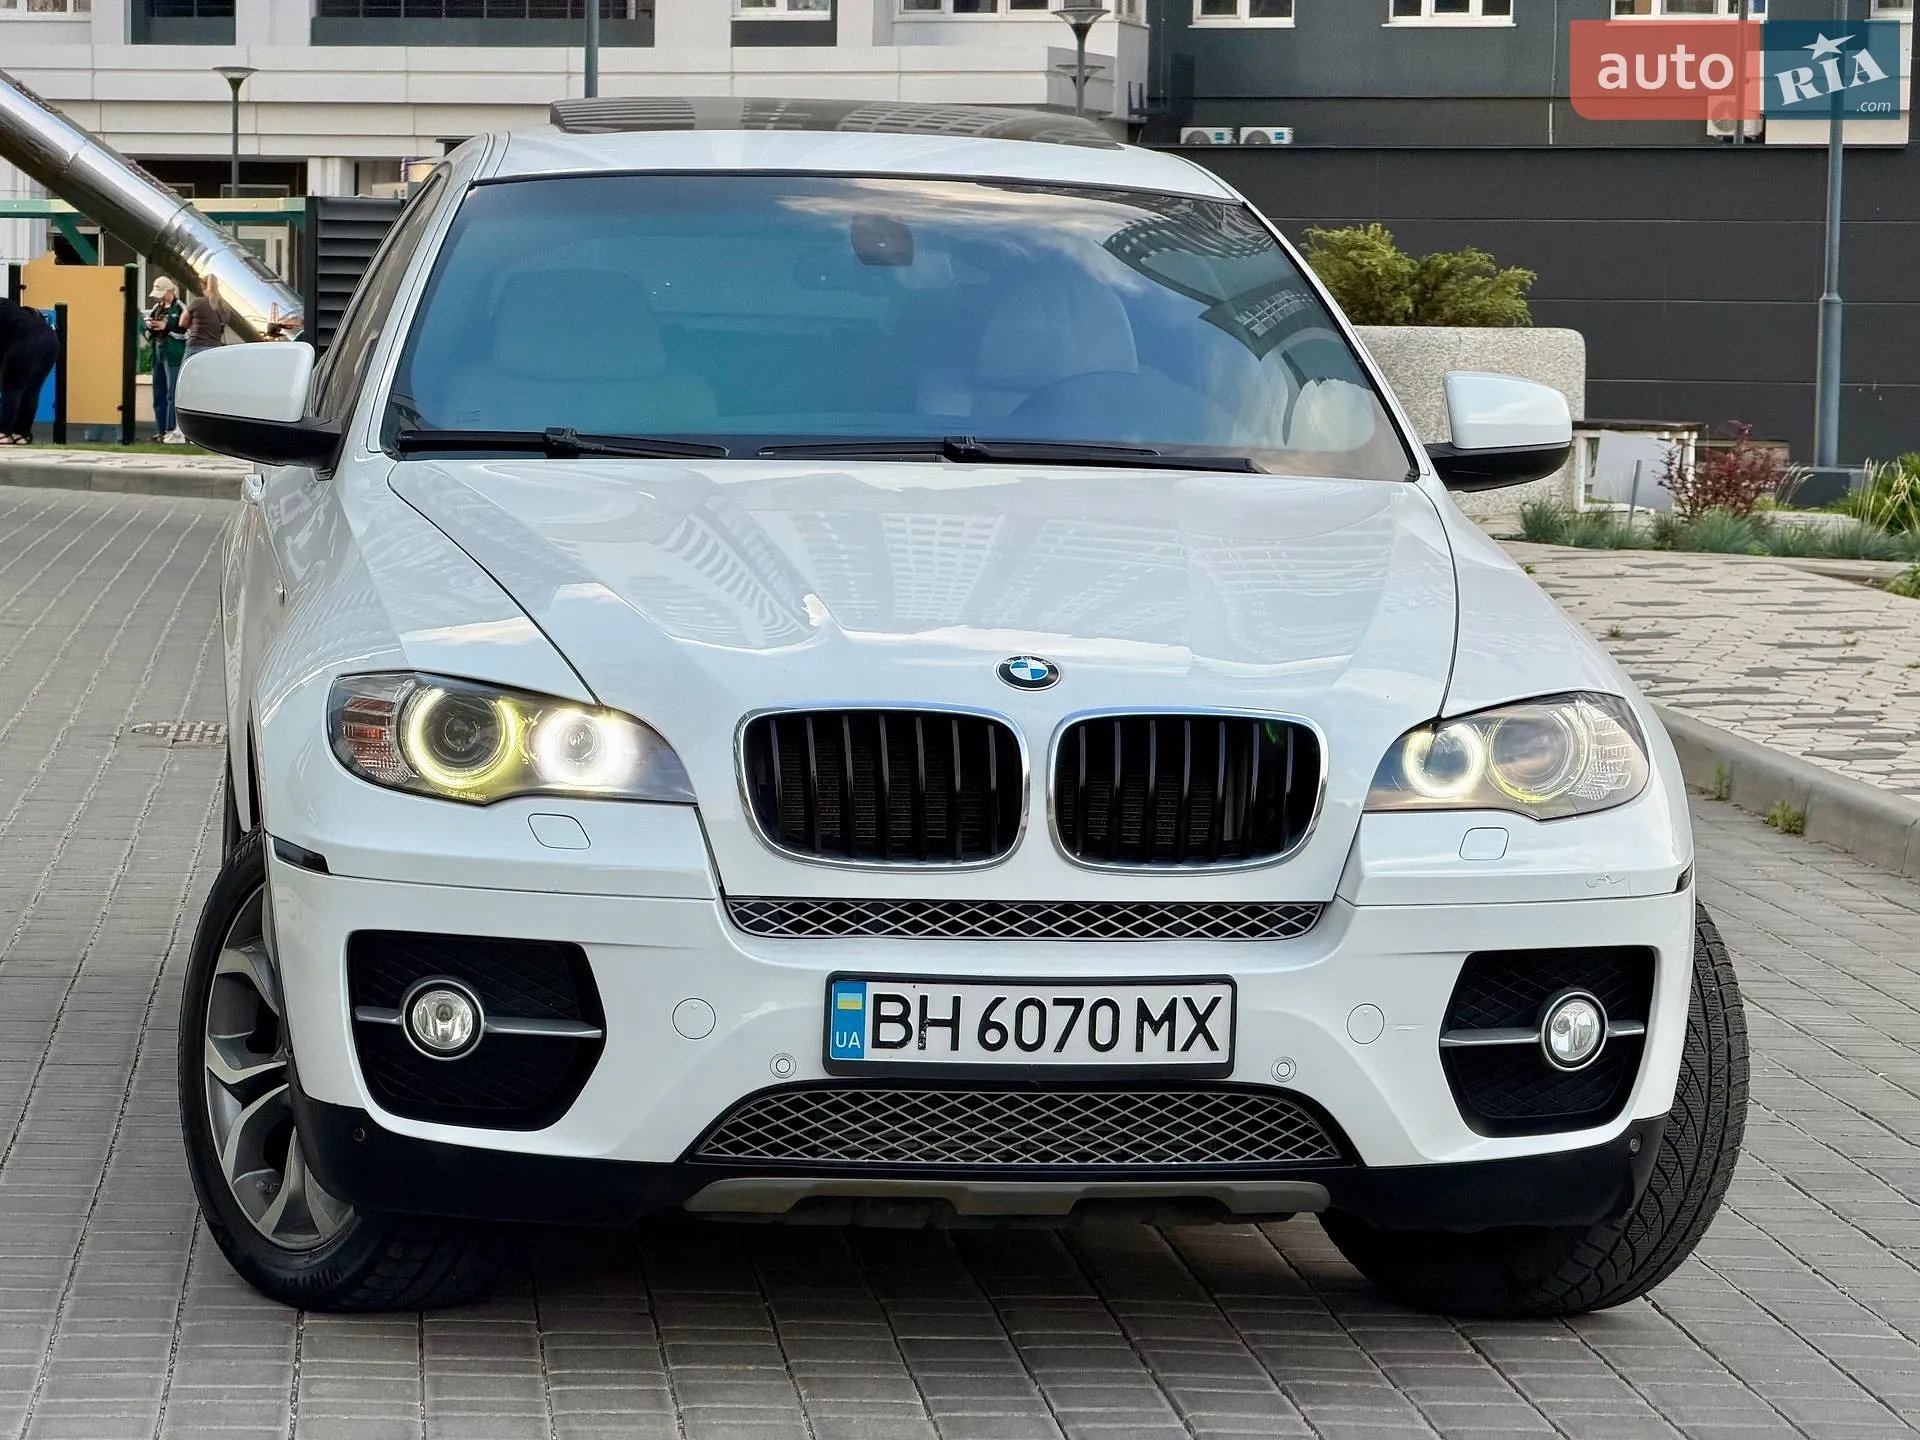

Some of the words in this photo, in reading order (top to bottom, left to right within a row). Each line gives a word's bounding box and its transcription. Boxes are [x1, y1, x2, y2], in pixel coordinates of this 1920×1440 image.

[836, 1031, 861, 1049] UA
[871, 993, 962, 1051] BH
[977, 996, 1120, 1054] 6070
[1134, 996, 1223, 1053] MX
